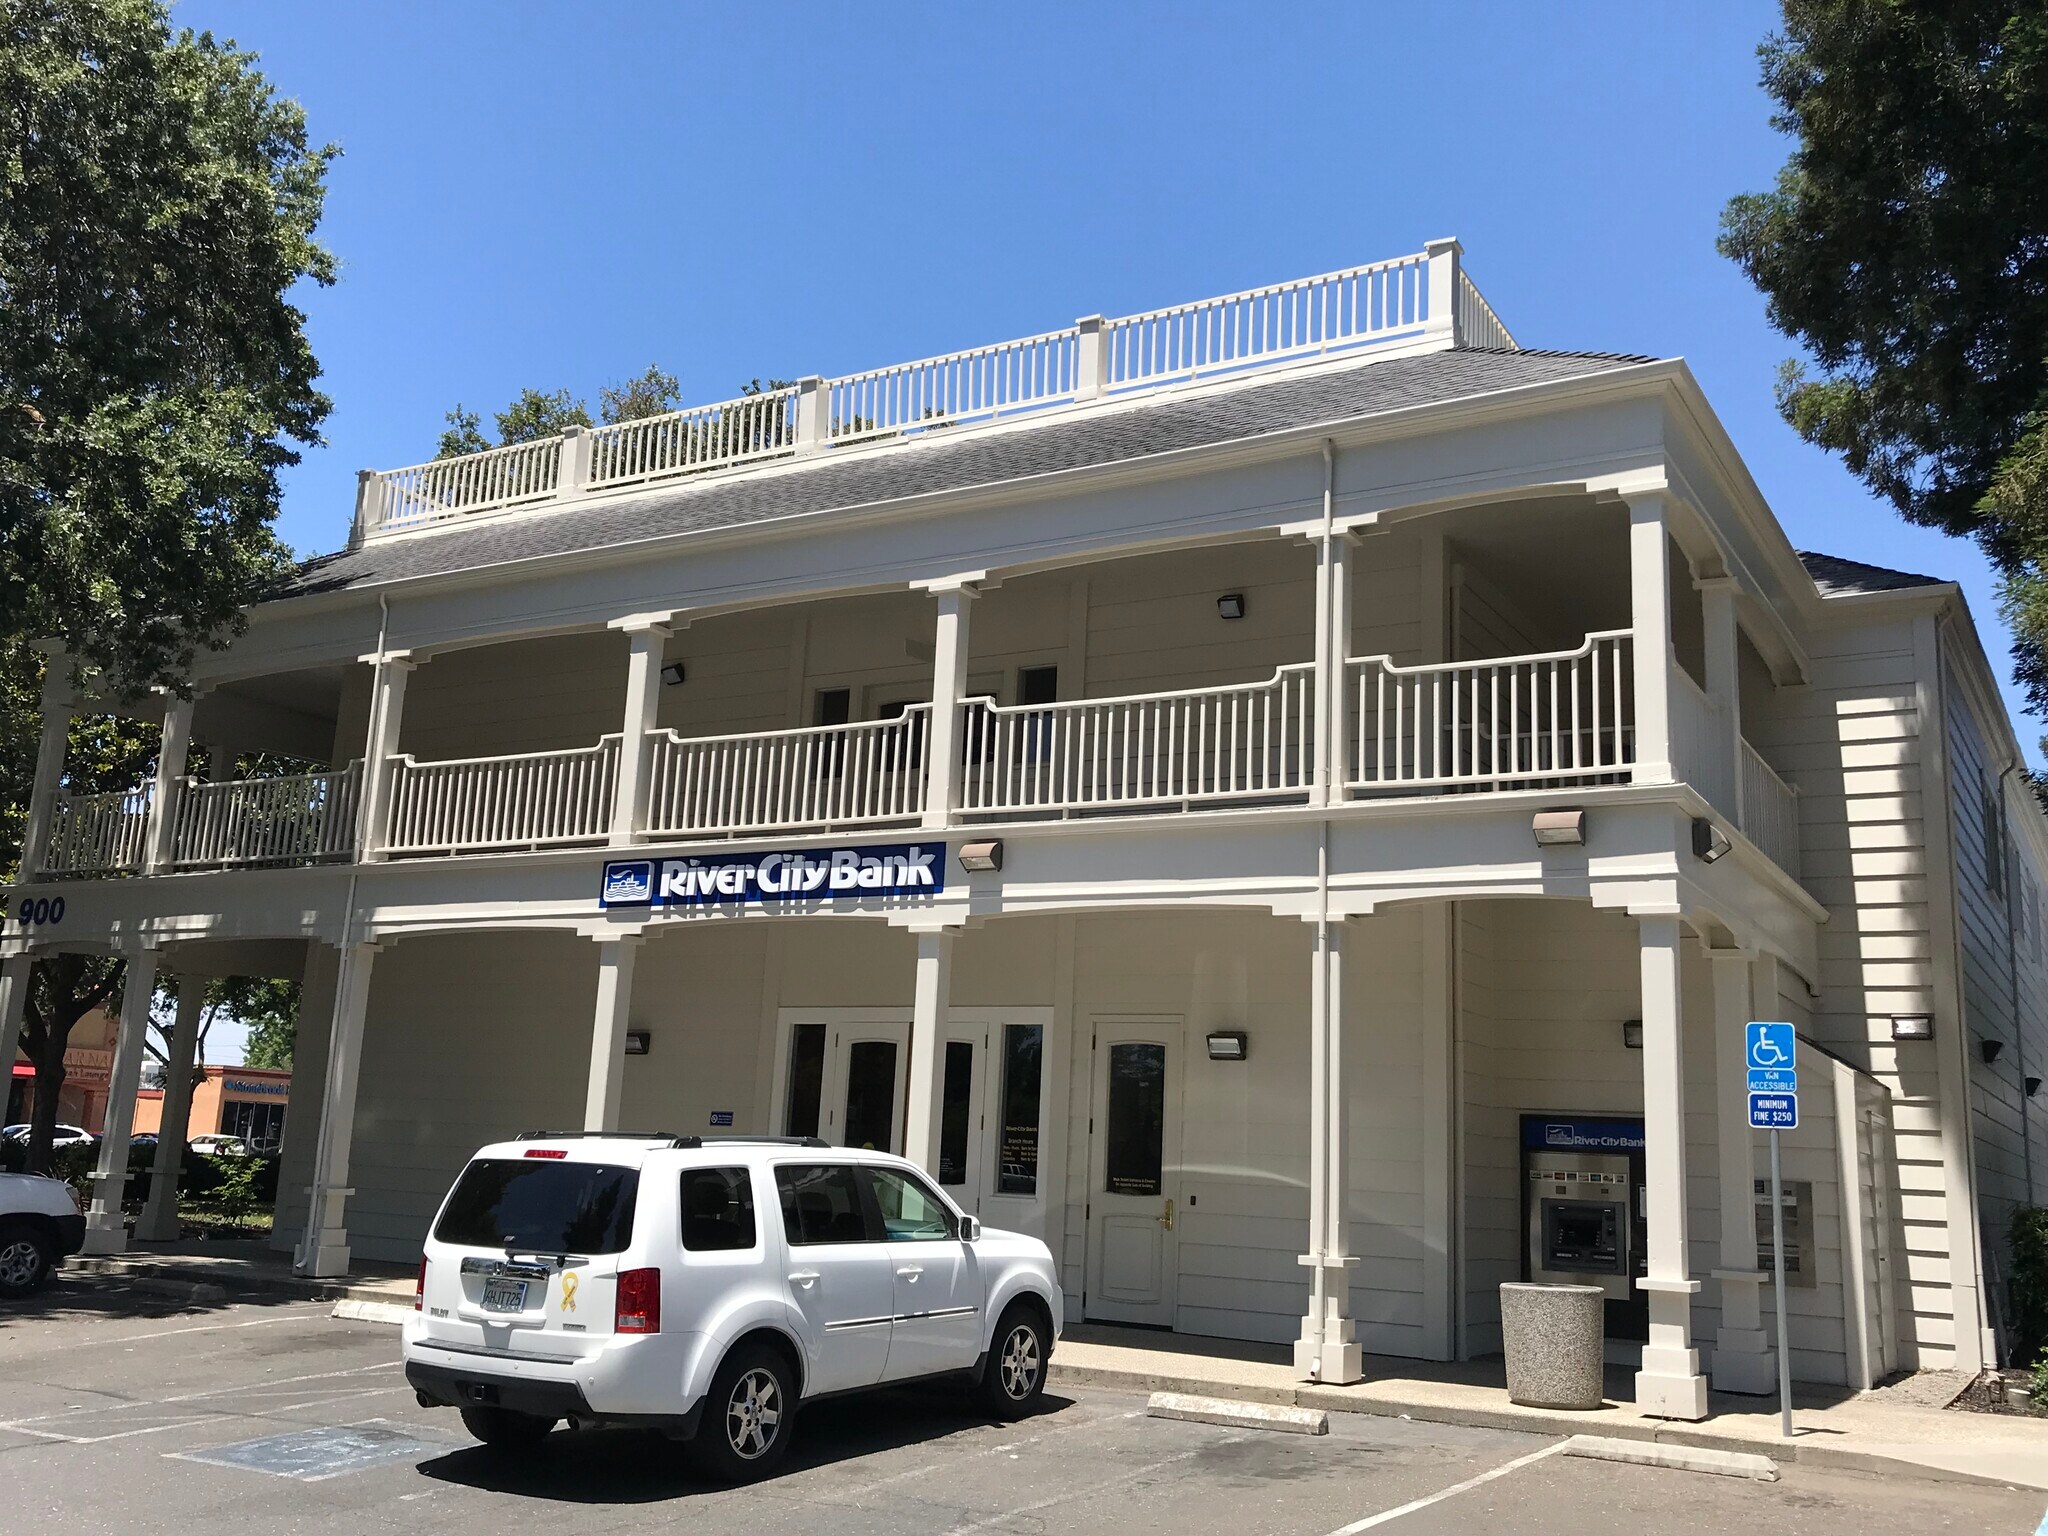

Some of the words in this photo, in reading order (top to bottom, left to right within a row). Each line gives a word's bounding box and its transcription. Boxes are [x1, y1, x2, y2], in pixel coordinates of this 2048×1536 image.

[19, 896, 65, 926] 900
[1764, 1071, 1779, 1080] VAN
[1750, 1081, 1795, 1091] ACCESSIBLE
[1757, 1099, 1788, 1110] MINIMUM
[1753, 1111, 1769, 1121] FINE
[1772, 1111, 1792, 1122] $250
